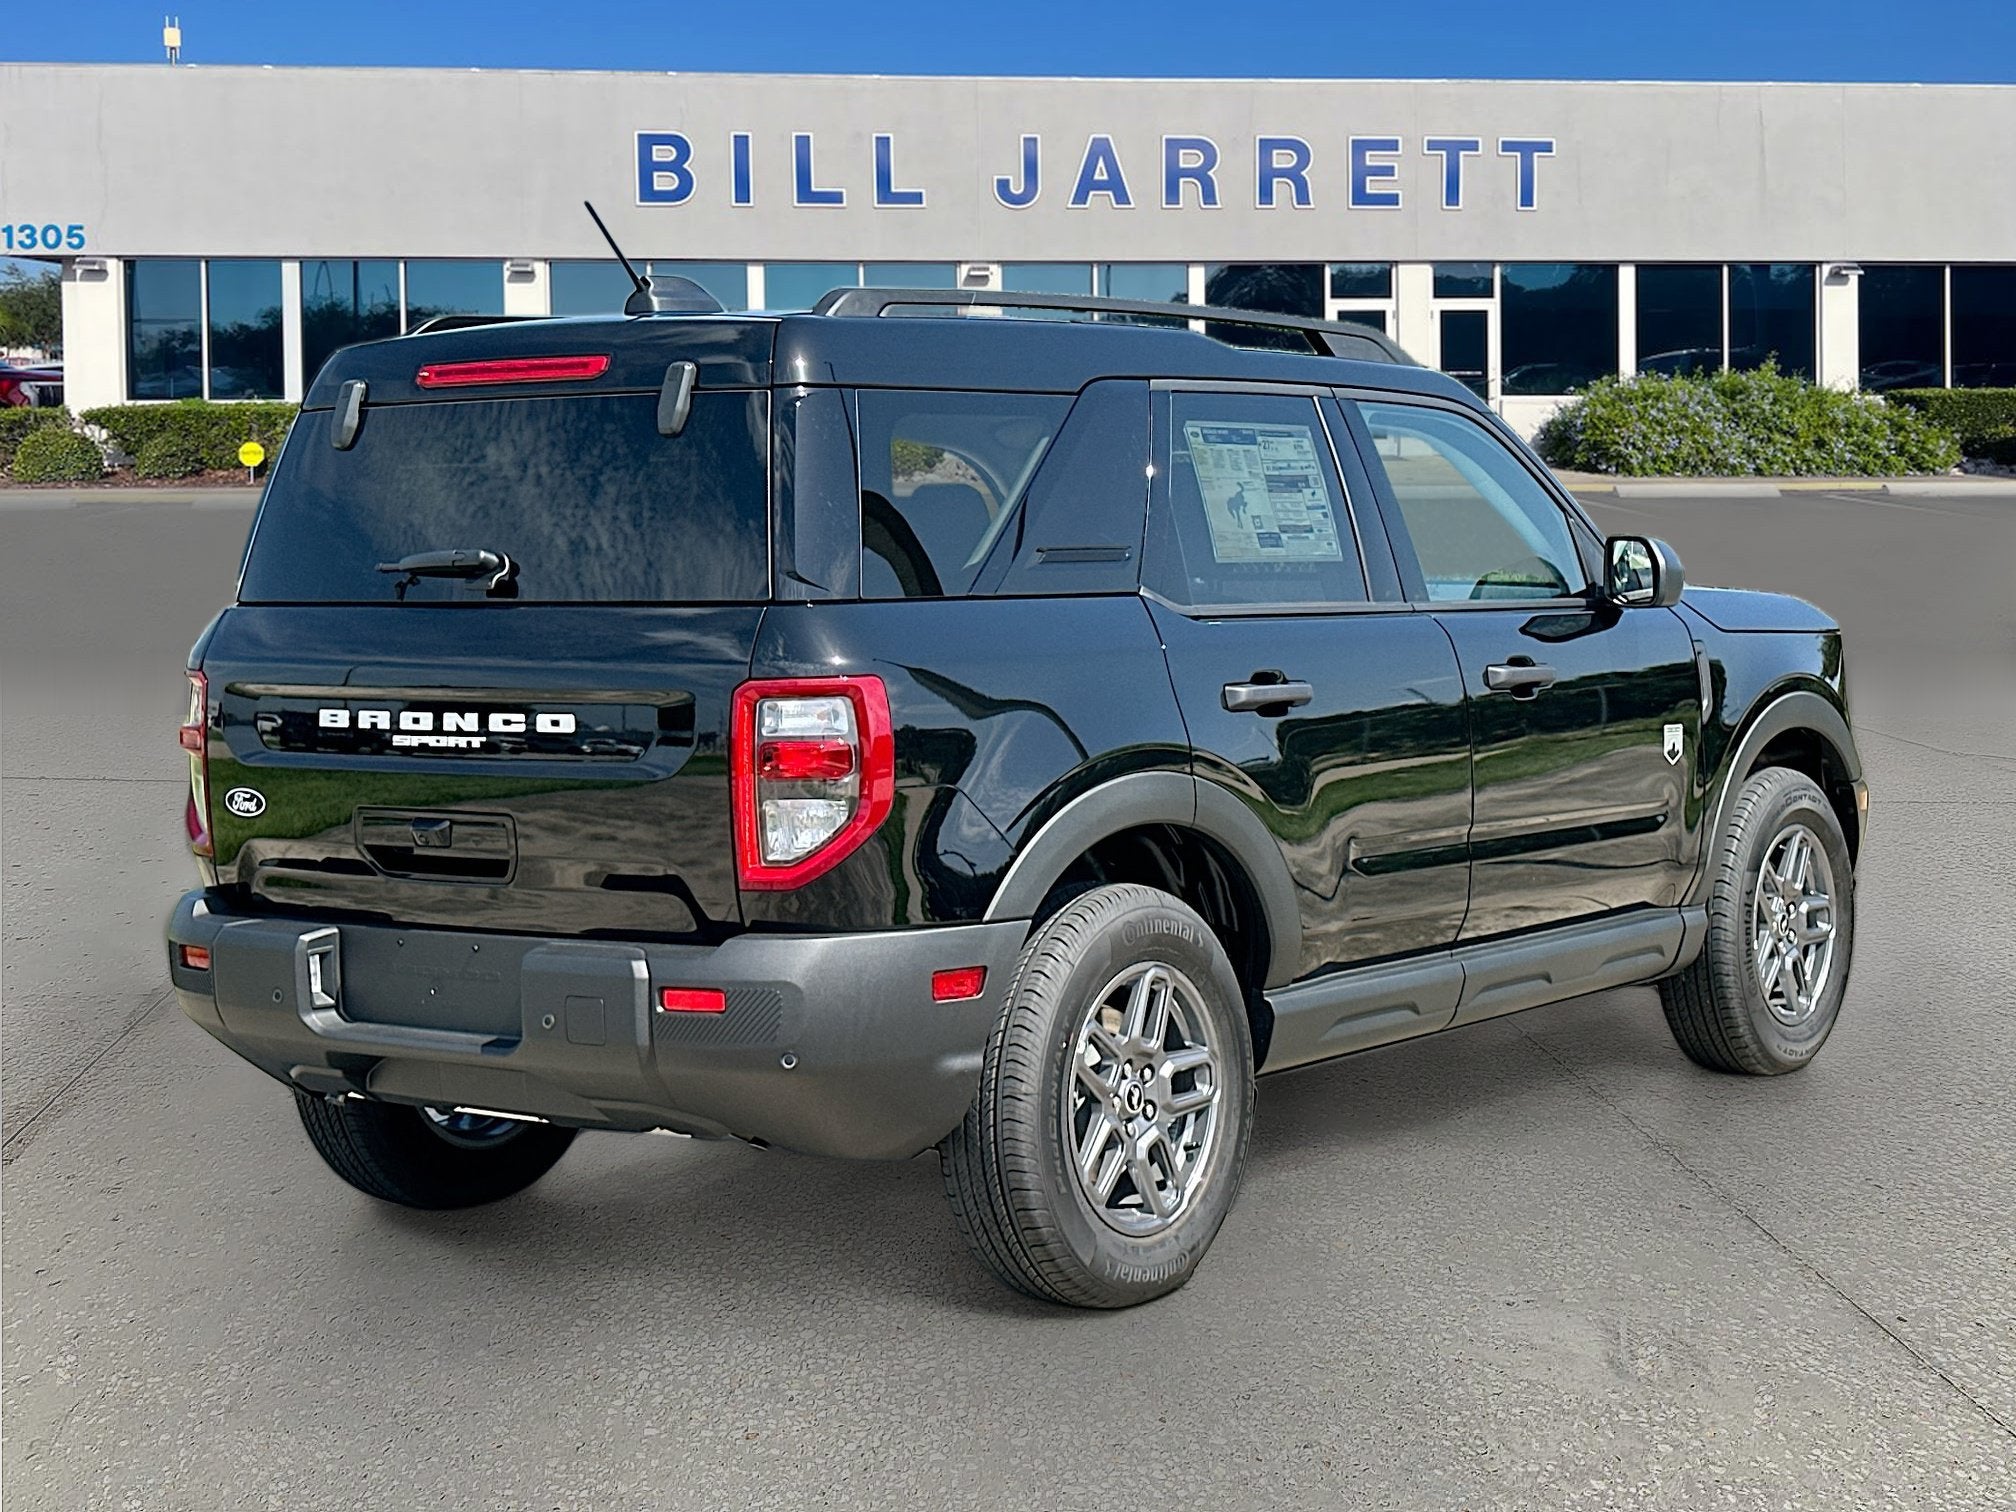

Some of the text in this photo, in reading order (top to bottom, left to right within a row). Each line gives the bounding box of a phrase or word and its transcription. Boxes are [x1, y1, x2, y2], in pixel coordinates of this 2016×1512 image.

[634, 130, 1557, 212] BILL JARRETT
[0, 224, 86, 250] 1305
[318, 708, 576, 734] BRONCO
[392, 735, 487, 748] SPORT
[230, 790, 260, 813] Ford
[1121, 918, 1195, 946] Continental
[1113, 1250, 1190, 1284] Continental
